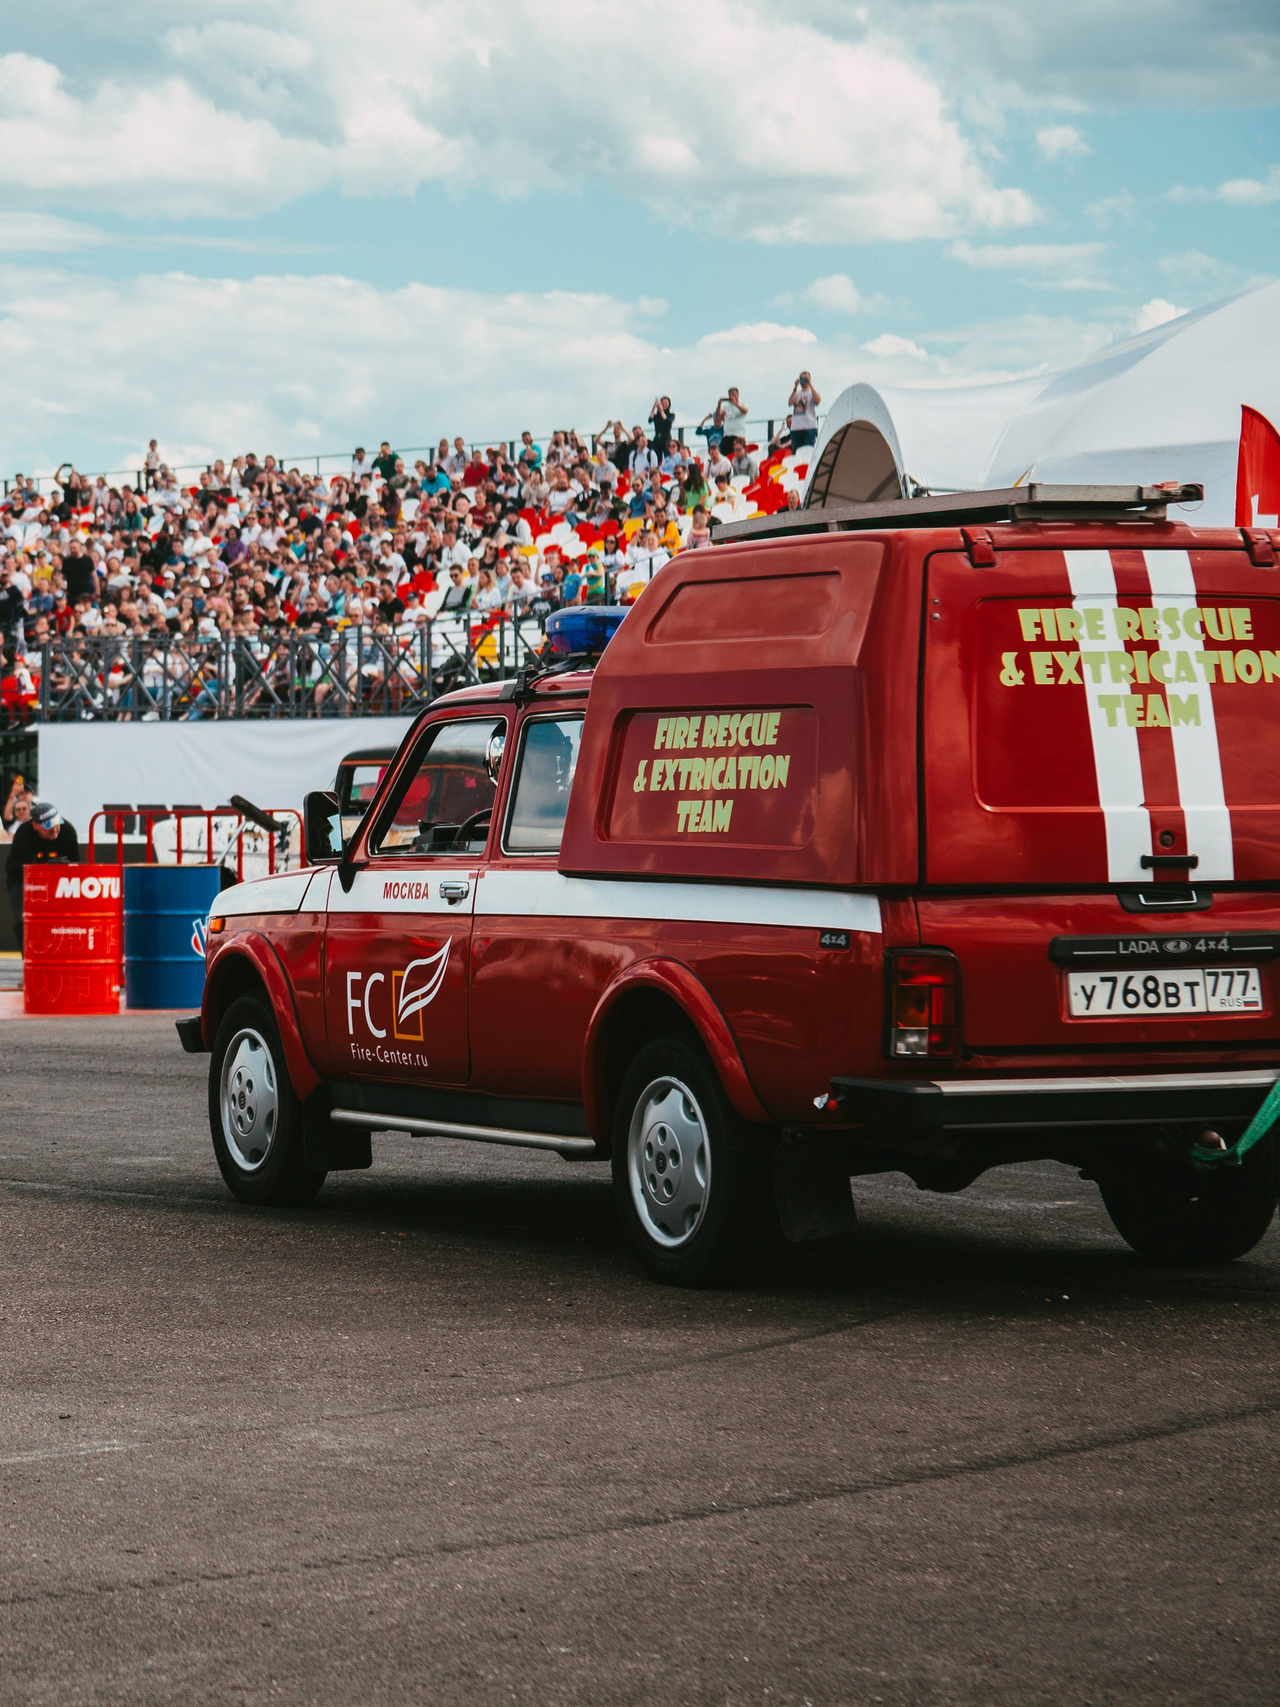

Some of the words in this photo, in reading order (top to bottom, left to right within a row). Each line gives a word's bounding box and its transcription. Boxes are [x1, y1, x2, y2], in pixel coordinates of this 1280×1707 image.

[1018, 607, 1107, 642] FIRE
[1112, 607, 1255, 642] RESCUE
[999, 651, 1025, 687] &
[1030, 649, 1280, 686] EXTRICATION
[1097, 693, 1202, 728] TEAM
[654, 716, 702, 750] FIRE
[701, 712, 782, 749] RESCUE
[633, 760, 649, 793] &
[649, 754, 791, 792] EXTRICATION
[677, 800, 734, 833] TEAM
[383, 882, 429, 900] МОСКВА
[51, 927, 87, 935] INGENIOUS
[821, 933, 847, 946] 4x4
[1119, 940, 1160, 954] LADA
[1206, 970, 1250, 997] 777
[346, 971, 387, 1038] FC
[1220, 998, 1243, 1008] RUS
[350, 1042, 429, 1067] Fire-Center.ru
